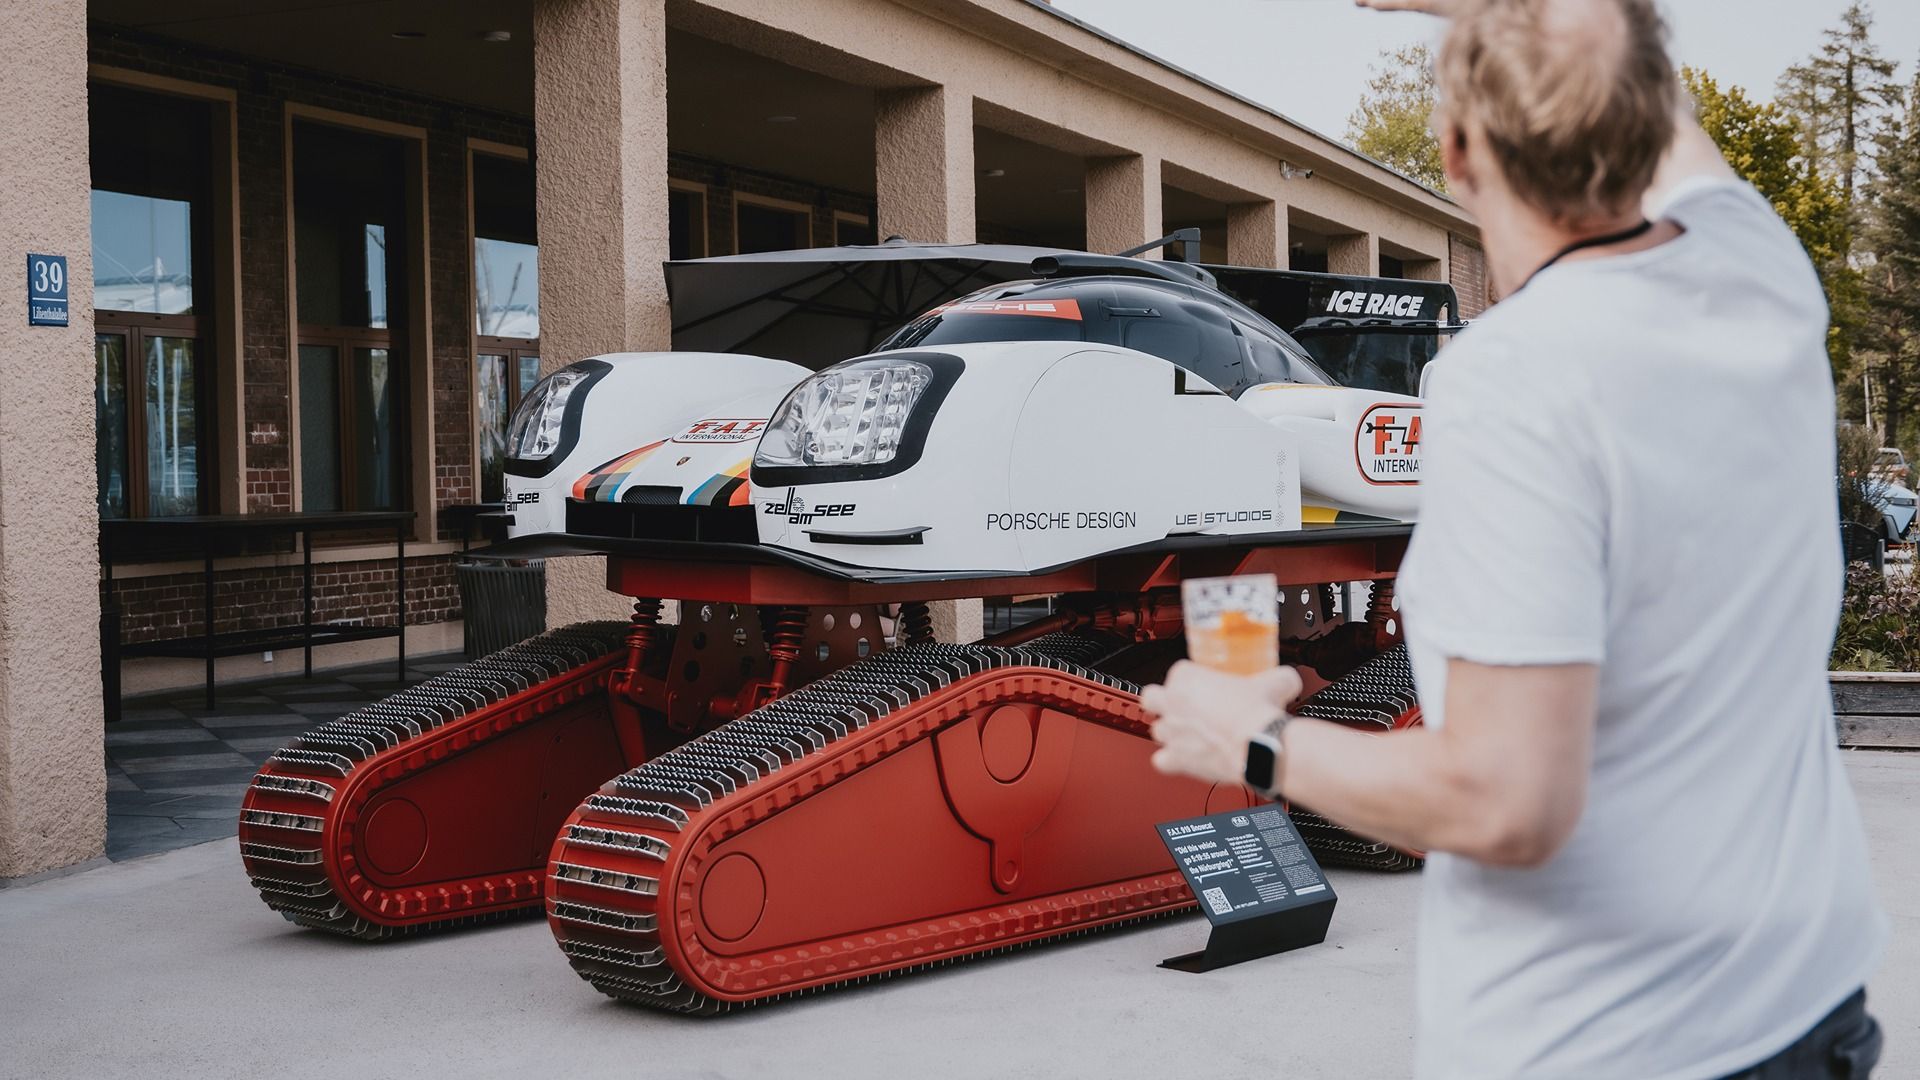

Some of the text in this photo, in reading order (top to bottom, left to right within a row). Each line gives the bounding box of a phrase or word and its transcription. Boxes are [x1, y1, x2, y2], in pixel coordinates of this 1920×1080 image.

[35, 261, 63, 293] 39
[1326, 290, 1424, 317] ICE RACE
[680, 433, 747, 441] INTERNATIONAL
[1374, 459, 1423, 473] INTERNA
[517, 492, 540, 504] see
[789, 513, 813, 525] am
[813, 503, 856, 517] see
[987, 511, 1136, 531] PORSCHE DESIGN
[1198, 840, 1217, 850] vehicle
[1210, 848, 1230, 858] around
